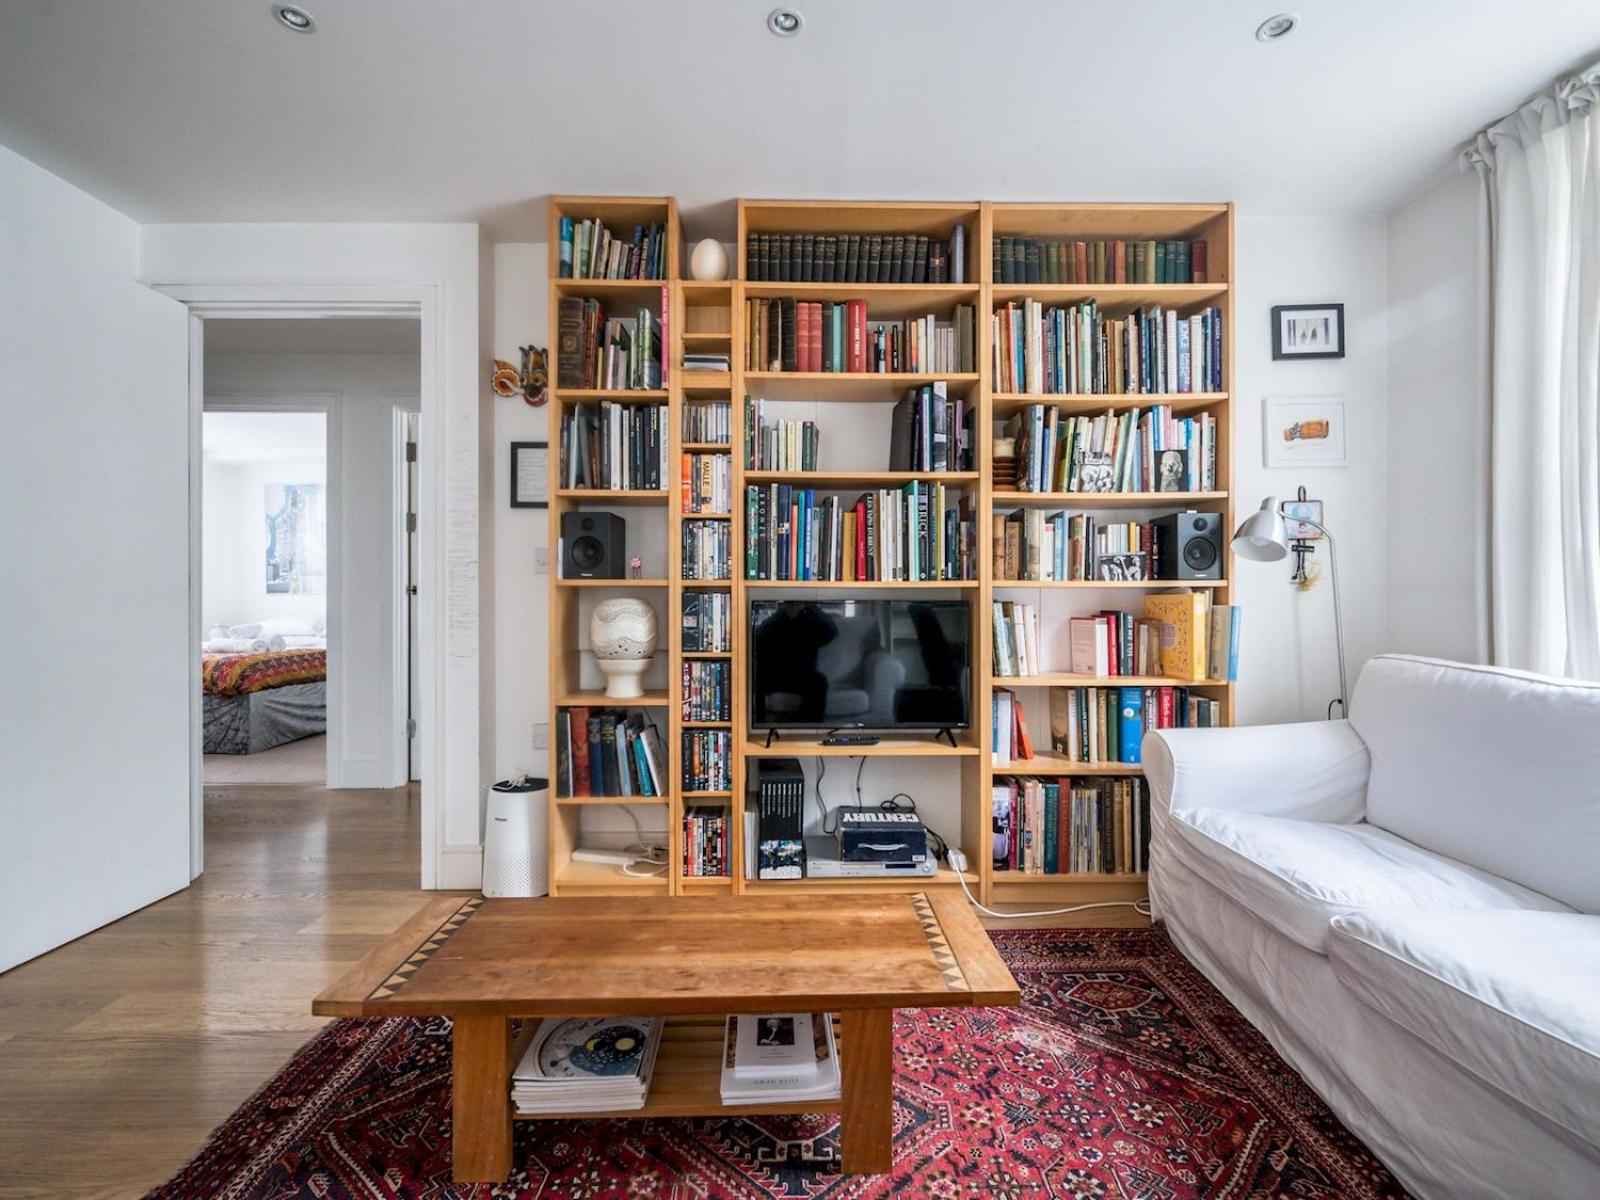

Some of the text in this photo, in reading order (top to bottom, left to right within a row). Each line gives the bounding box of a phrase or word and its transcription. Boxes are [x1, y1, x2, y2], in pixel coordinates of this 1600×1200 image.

[702, 461, 711, 486] MALLE
[918, 505, 928, 538] BRICK
[843, 812, 919, 823] CENTURY
